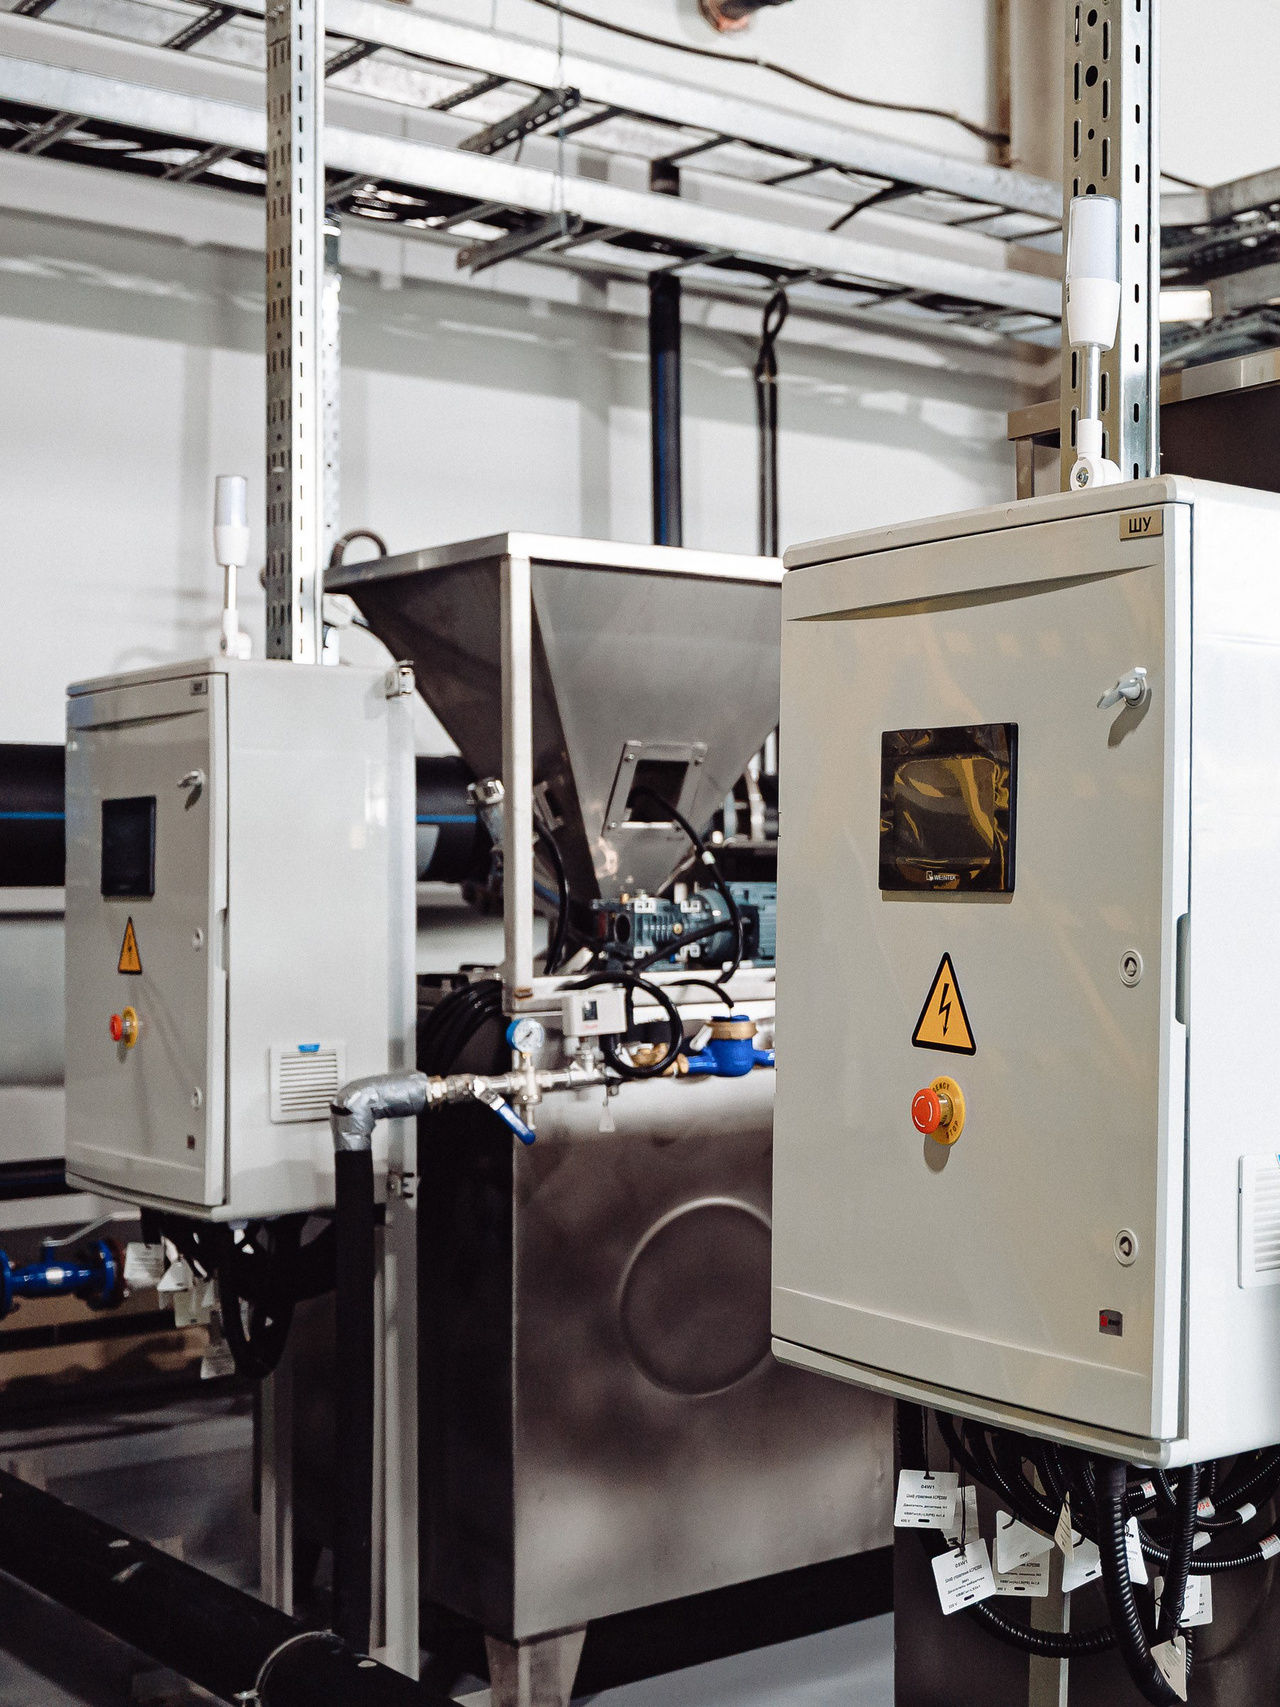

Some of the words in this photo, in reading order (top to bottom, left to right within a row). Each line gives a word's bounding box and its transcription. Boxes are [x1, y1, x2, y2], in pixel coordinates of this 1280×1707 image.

[1128, 515, 1152, 534] ШУ
[933, 873, 957, 881] WEINTEK
[945, 1120, 959, 1139] STOP
